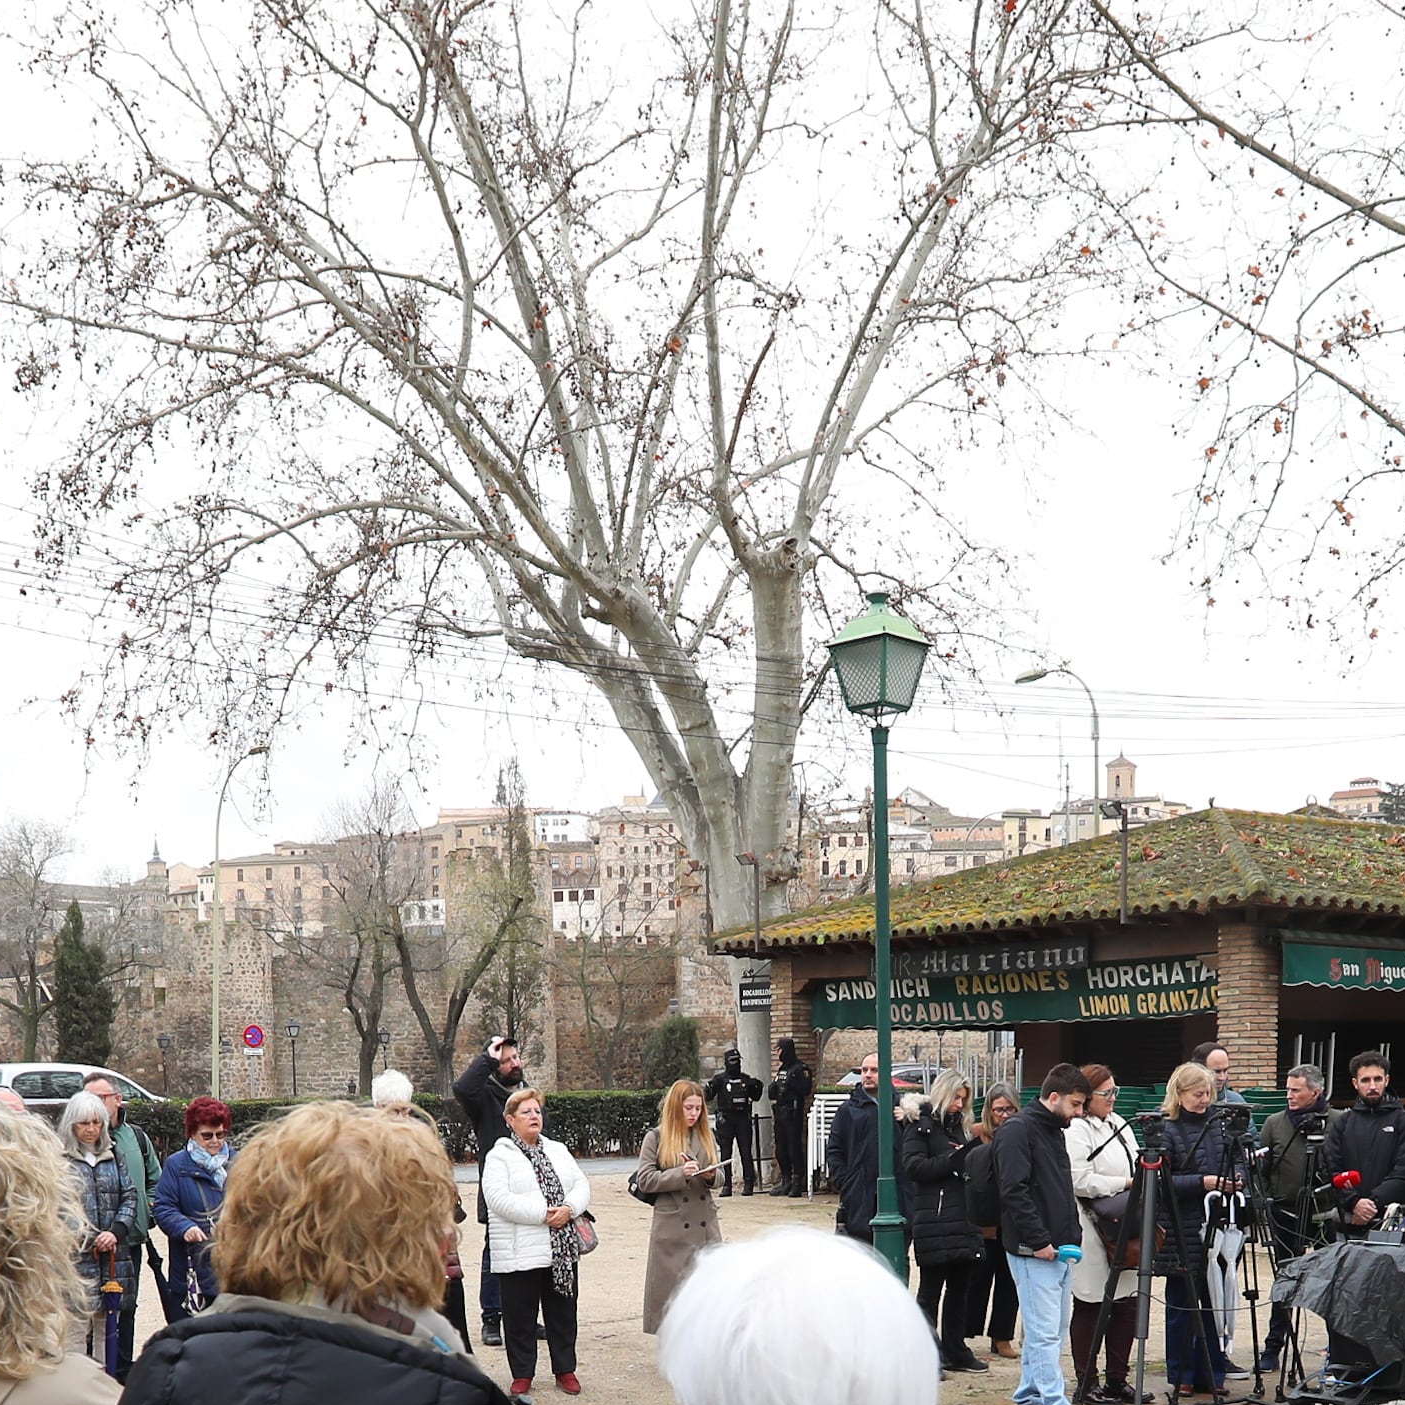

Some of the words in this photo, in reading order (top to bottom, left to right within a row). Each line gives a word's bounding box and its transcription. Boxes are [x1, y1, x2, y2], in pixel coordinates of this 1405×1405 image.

[920, 946, 1085, 974] Mariano
[1329, 957, 1360, 981] San
[825, 977, 930, 1002] SANDICH
[955, 969, 1070, 995] RACIONES
[1086, 960, 1217, 989] HORCHATA
[890, 1000, 1004, 1023] OCADILLOS
[1079, 994, 1131, 1017] LIMON
